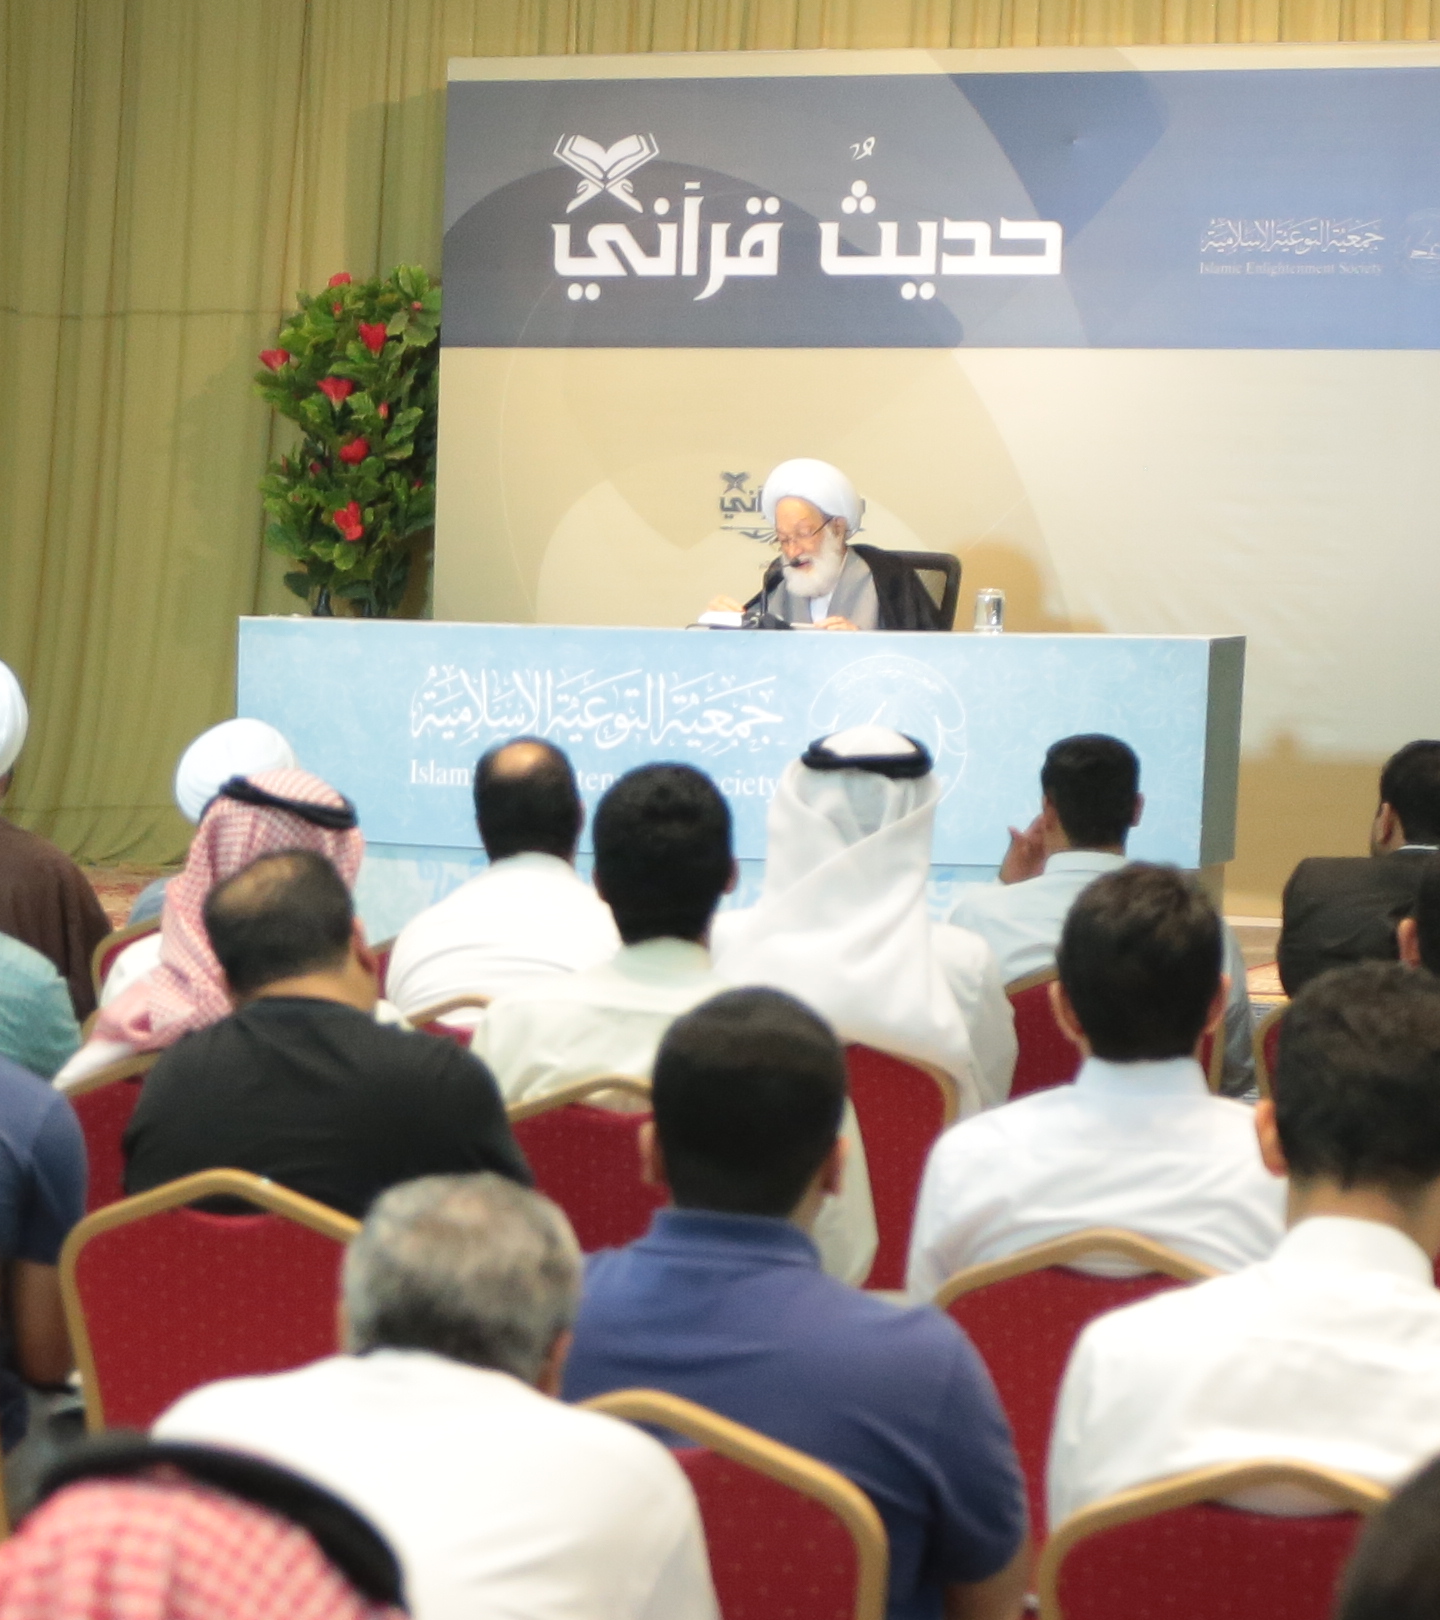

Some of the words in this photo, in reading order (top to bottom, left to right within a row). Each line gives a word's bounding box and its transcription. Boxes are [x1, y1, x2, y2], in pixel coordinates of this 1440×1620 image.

[551, 181, 784, 301] قرآني
[1200, 262, 1241, 275] Islamic
[1246, 262, 1335, 277] Enlightenment
[1339, 262, 1382, 276] Society
[410, 759, 477, 786] Islam
[720, 769, 780, 804] ciety
